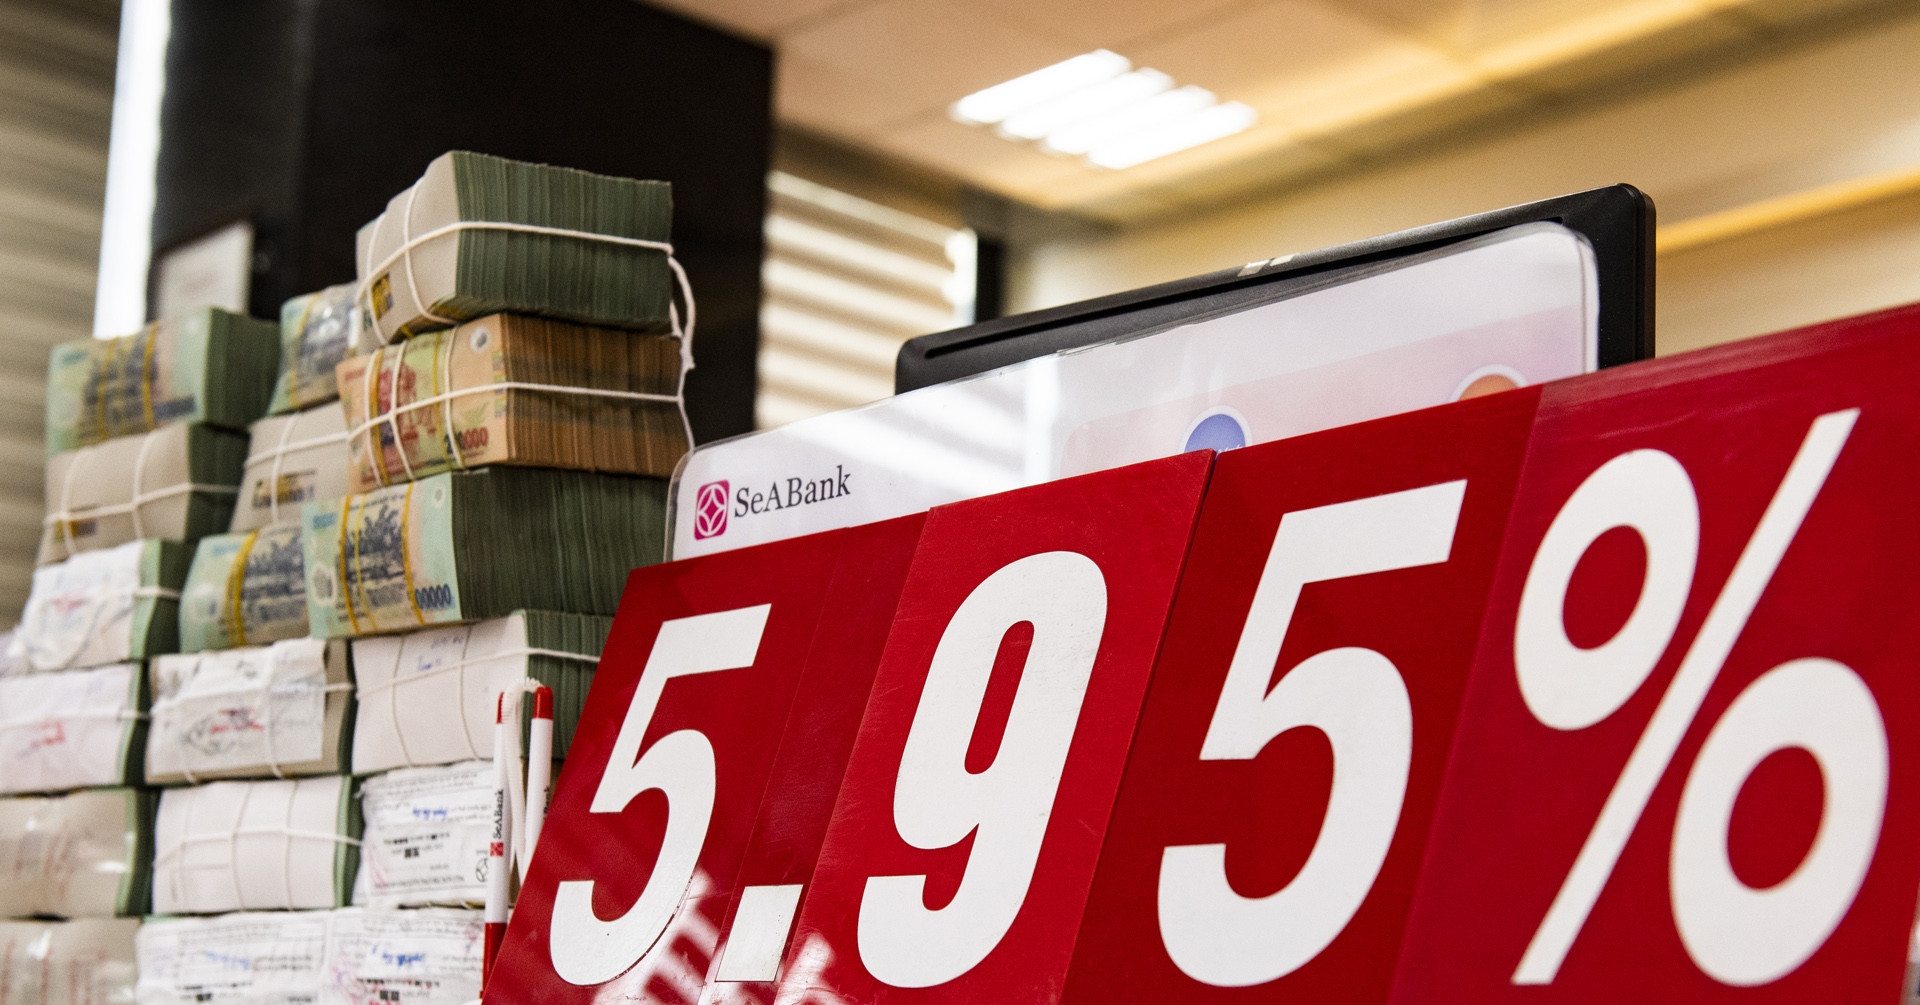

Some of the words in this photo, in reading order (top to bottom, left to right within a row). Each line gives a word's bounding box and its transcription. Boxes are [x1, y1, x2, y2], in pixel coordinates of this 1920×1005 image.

[734, 464, 851, 518] SeABank
[549, 409, 1889, 987] 5.95%
[493, 789, 504, 839] SeABank
